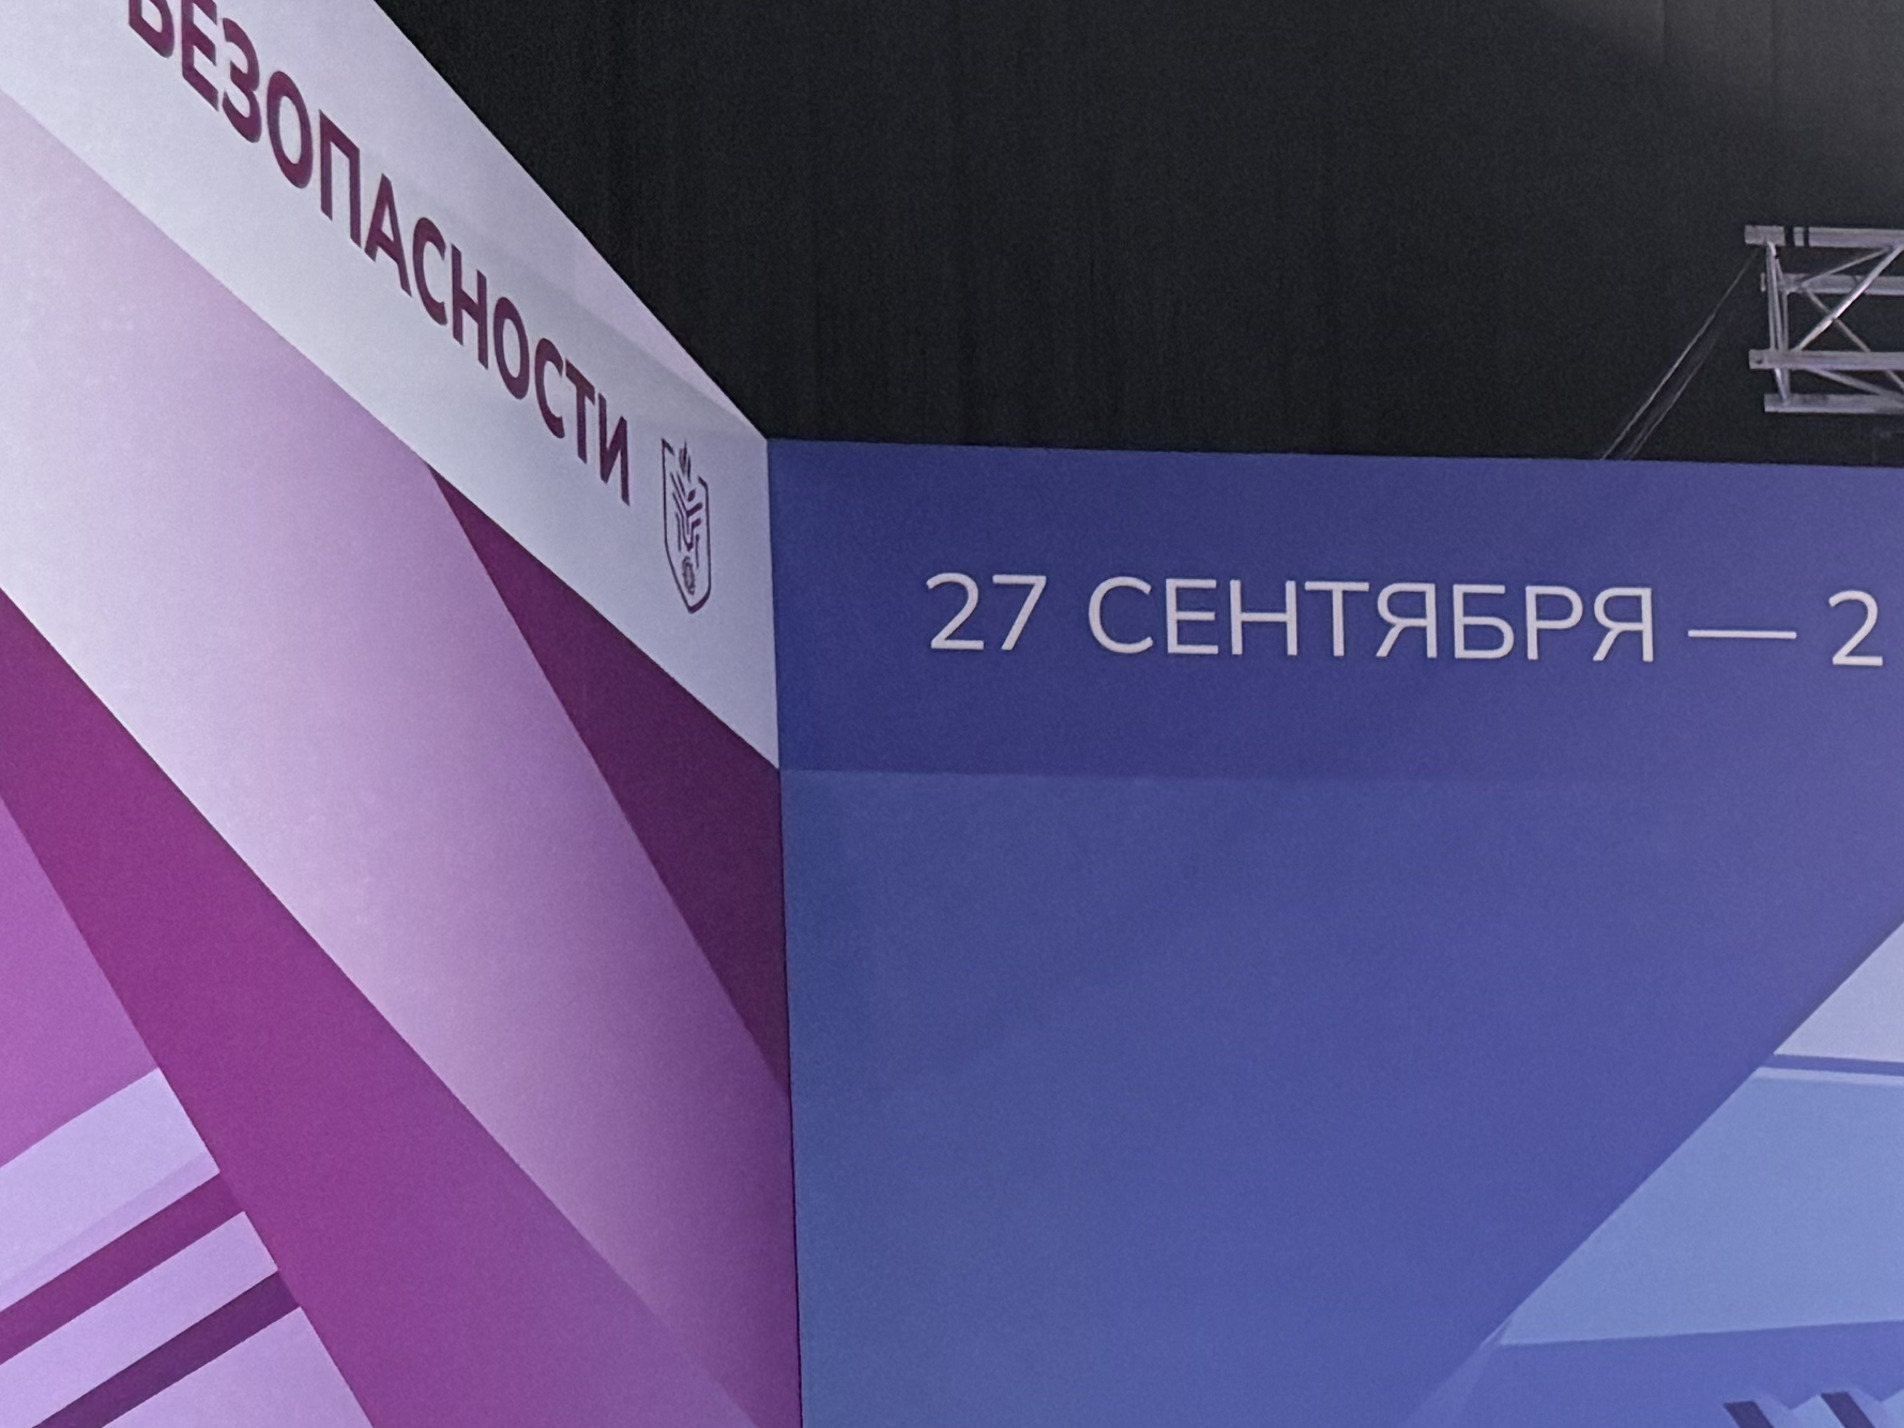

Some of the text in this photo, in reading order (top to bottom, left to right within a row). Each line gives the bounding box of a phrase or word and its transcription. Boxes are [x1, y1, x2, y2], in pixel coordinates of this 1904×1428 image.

[926, 572, 1047, 651] 27
[1087, 576, 1655, 662] СЕНТЯБРЯ
[1827, 589, 1884, 668] 2
